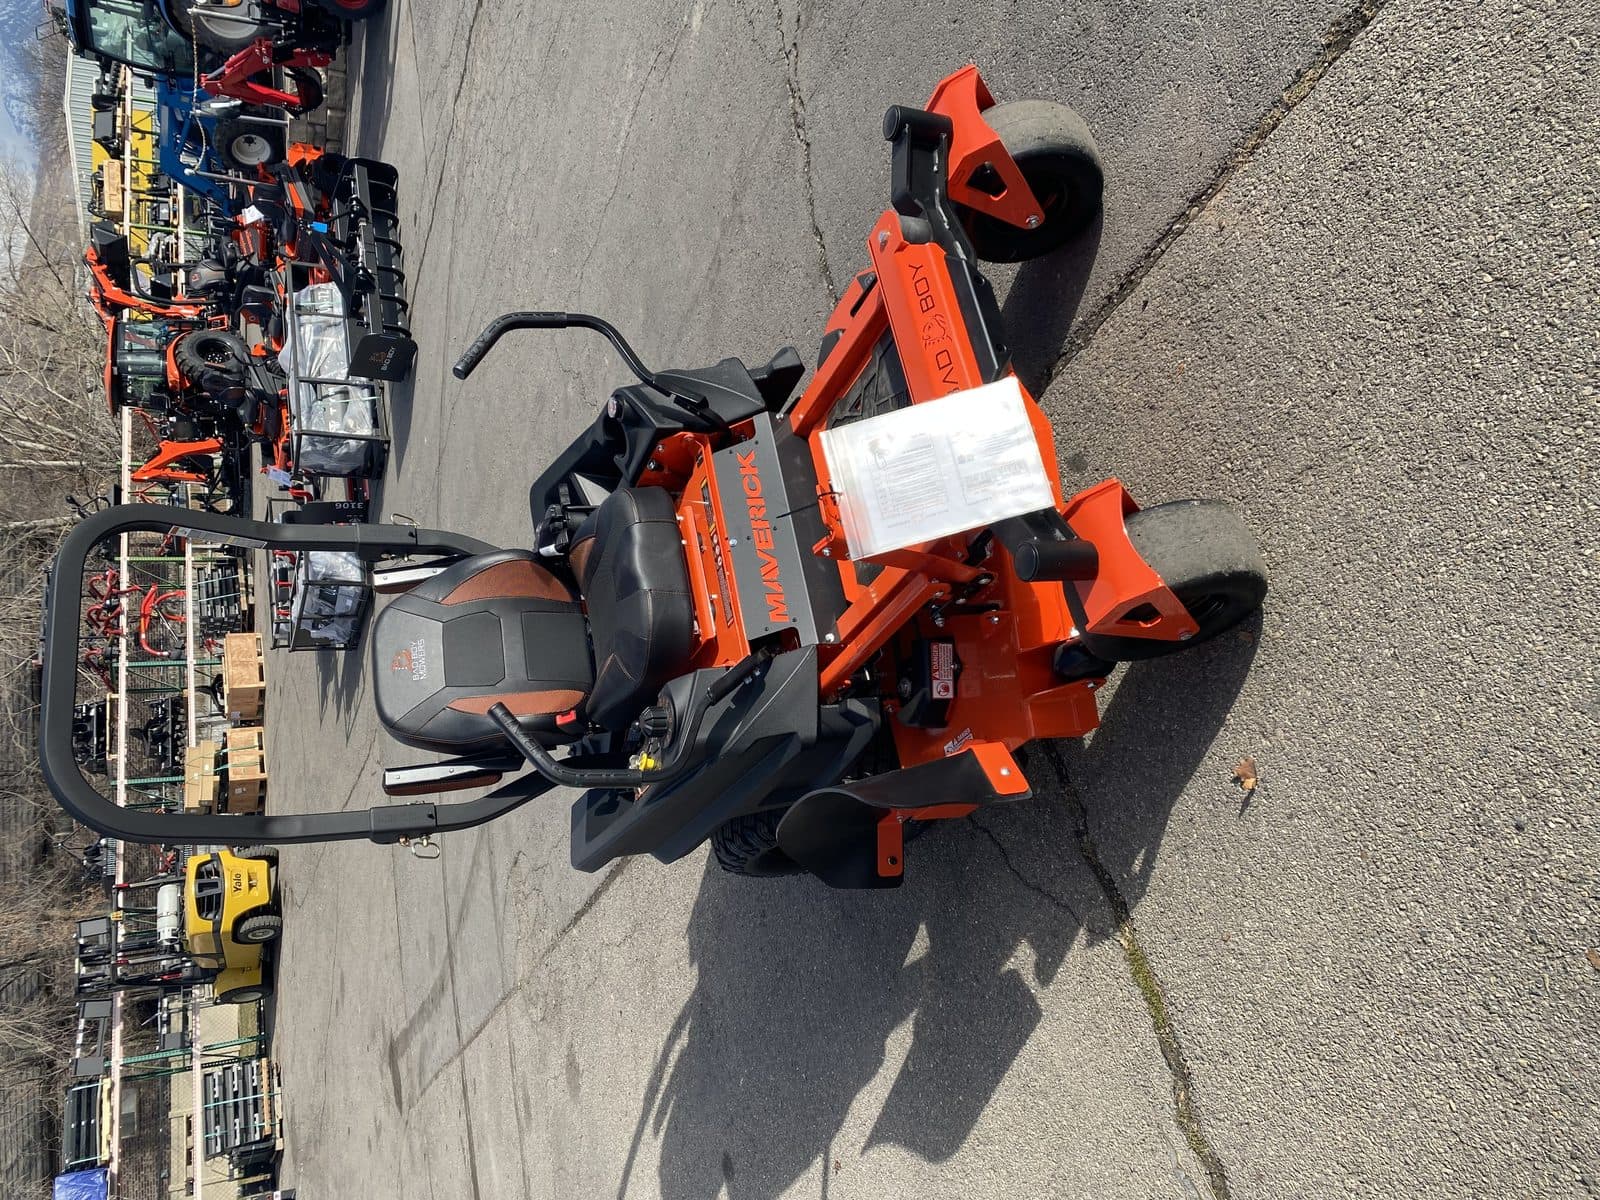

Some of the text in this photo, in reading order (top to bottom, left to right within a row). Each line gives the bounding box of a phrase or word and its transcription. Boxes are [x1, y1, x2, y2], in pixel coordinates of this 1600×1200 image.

[908, 264, 935, 313] BOY
[736, 451, 789, 623] MAVERICK
[410, 641, 420, 681] BAD BOY
[417, 639, 427, 680] MOWERS
